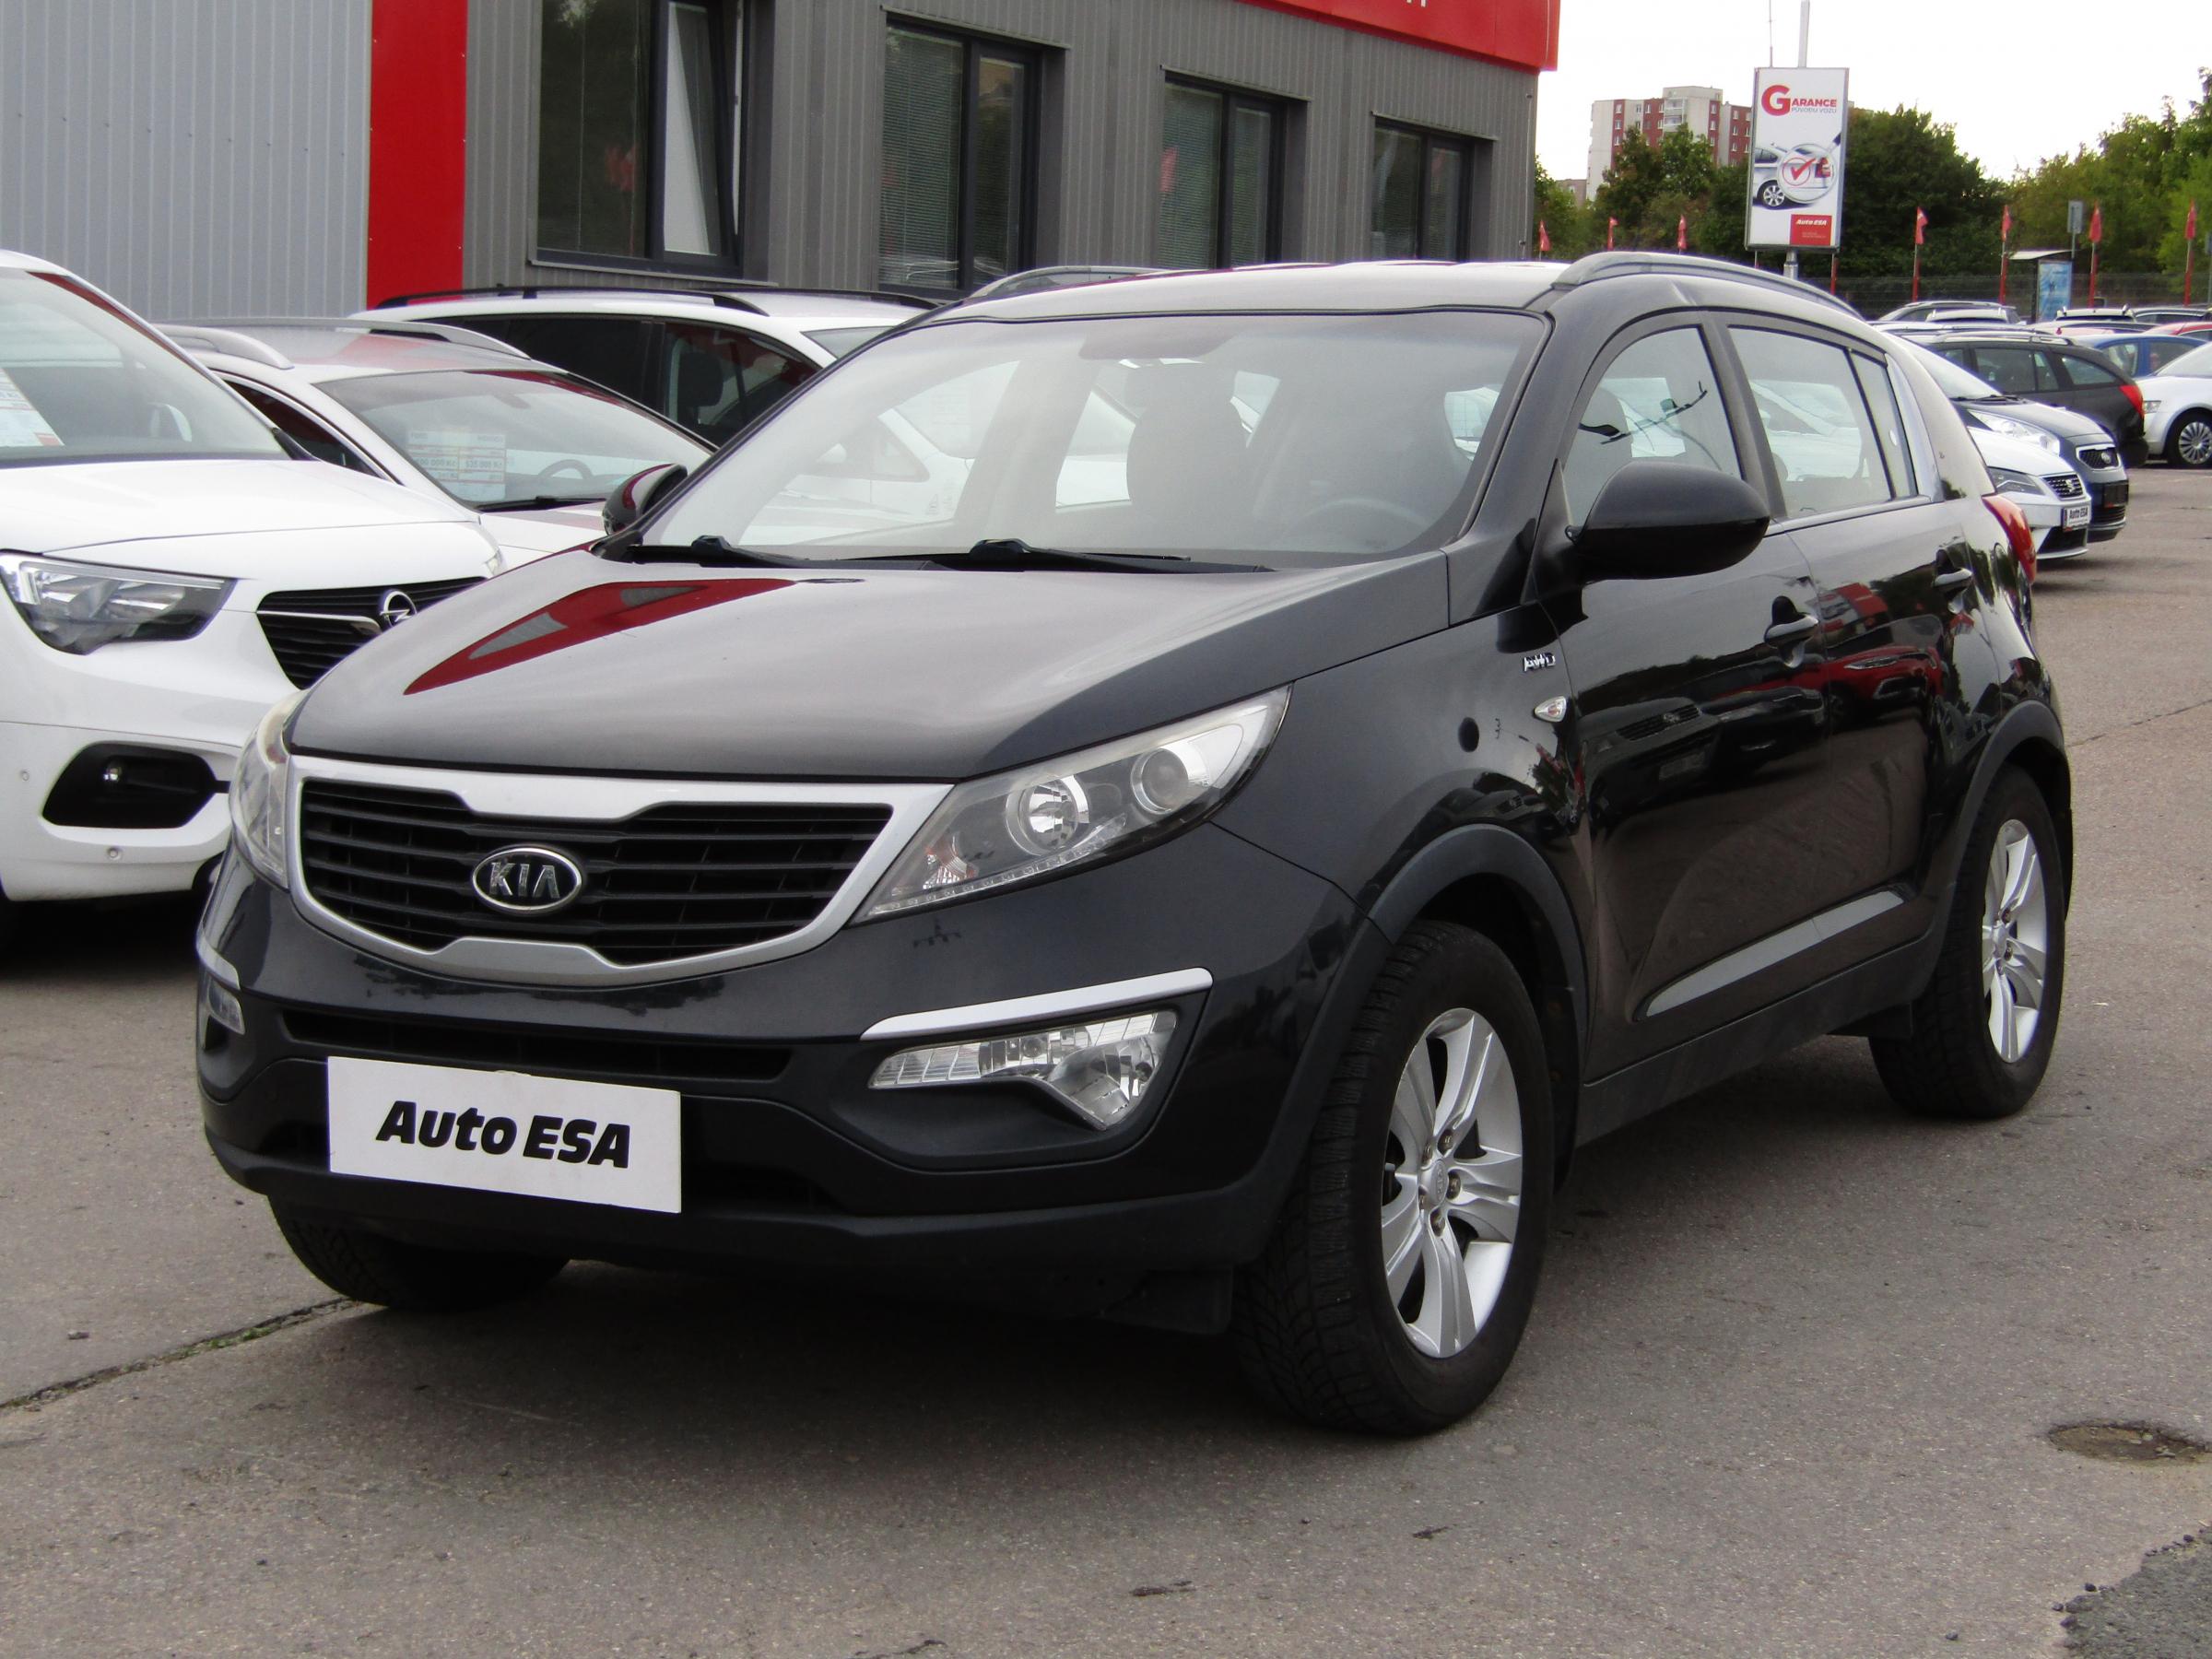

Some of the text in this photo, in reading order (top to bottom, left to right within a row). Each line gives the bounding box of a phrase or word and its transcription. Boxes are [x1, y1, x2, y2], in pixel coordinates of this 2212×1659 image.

[1761, 85, 1837, 116] GARANCE
[2069, 509, 2080, 519] Auto
[1524, 653, 1556, 672] AWD
[489, 862, 560, 899] KIA
[376, 1100, 630, 1169] Auto ESA
